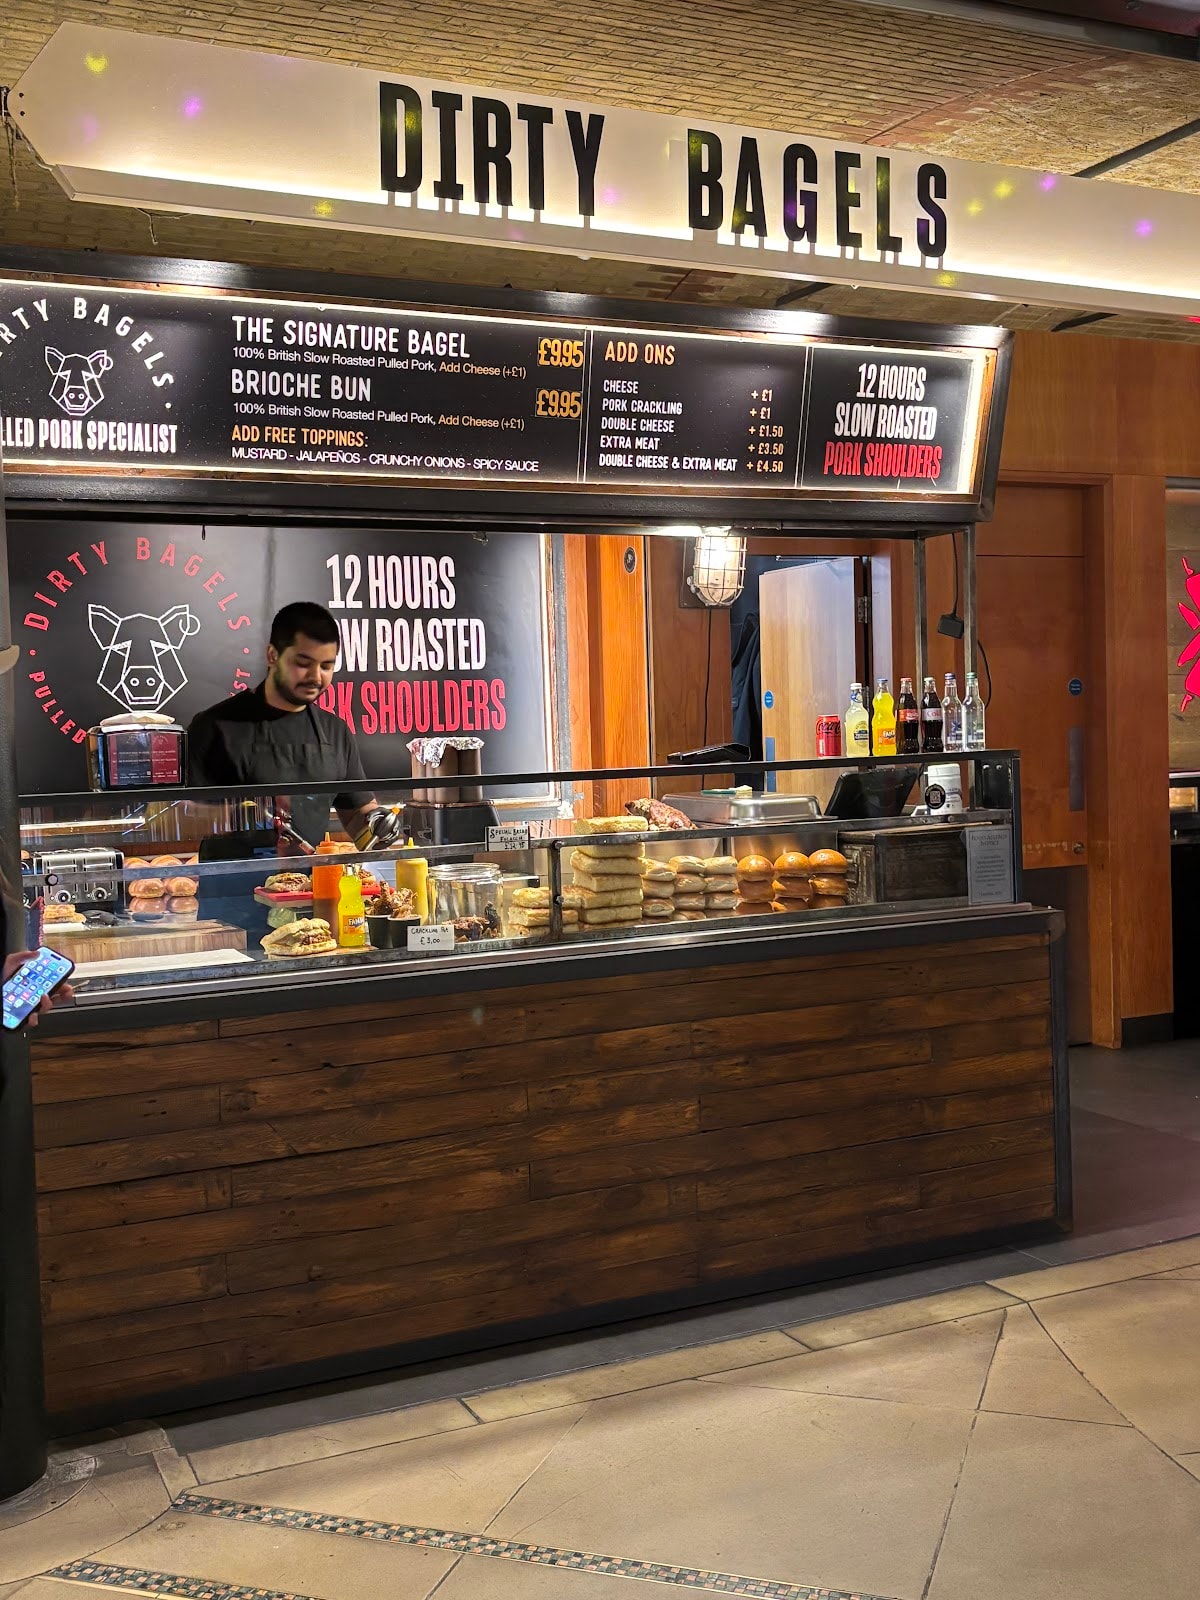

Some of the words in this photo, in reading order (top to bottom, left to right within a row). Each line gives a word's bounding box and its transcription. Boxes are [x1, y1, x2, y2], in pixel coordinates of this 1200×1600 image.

[379, 81, 605, 216] DIRTY
[687, 128, 948, 257] BAGELS
[0, 299, 49, 345] RTY
[73, 297, 175, 388] BAGELS
[232, 315, 274, 343] THE
[283, 320, 399, 353] SIGNATURE
[408, 329, 470, 358] BAGEL
[233, 347, 265, 359] 100%
[268, 349, 301, 362] British
[303, 351, 329, 364] Slow
[332, 353, 375, 367] Roasted
[378, 357, 408, 370] Pulled
[411, 359, 437, 373] Pork,
[439, 361, 460, 373] Add
[462, 363, 500, 376] Cheese
[502, 366, 527, 379] (+£1)
[538, 338, 584, 368] £9.95
[605, 341, 638, 363] ADD
[644, 343, 676, 366] ONS
[231, 368, 322, 398] BRIOCHE
[330, 375, 371, 402] BUN
[603, 379, 639, 394] CHEESE
[751, 390, 759, 399] +
[761, 389, 773, 402] £1
[856, 363, 877, 398] 12
[878, 364, 927, 401] HOURS
[233, 402, 265, 415] 100%
[268, 404, 301, 417] British
[303, 406, 329, 418] Slow
[332, 408, 375, 421] Roasted
[377, 410, 408, 423] Pulled
[410, 413, 436, 426] Pork,
[438, 415, 459, 426] Add
[461, 416, 499, 428] Cheese
[501, 418, 525, 432] (+£1)
[536, 389, 583, 418] £9.95
[602, 398, 627, 412] PORK
[631, 400, 683, 415] CRACKLING
[750, 408, 757, 417] +
[760, 407, 771, 420] £1
[38, 418, 83, 450] PORK
[86, 420, 178, 453] SPECIALIST
[231, 424, 260, 442] ADD
[264, 426, 297, 444] FREE
[301, 428, 369, 447] TOPPINGS:
[601, 417, 636, 431] DOUBLE
[640, 418, 675, 433] CHEESE
[749, 426, 756, 435] +
[759, 425, 784, 438] £1.50
[834, 401, 877, 438] SLOW
[876, 403, 938, 441] ROASTED
[600, 435, 632, 449] EXTRA
[635, 437, 660, 450] MEAT
[748, 443, 755, 452] +
[758, 443, 784, 456] £3.50
[231, 447, 287, 460] MUSTARD
[369, 453, 423, 466] CRUNCHY
[424, 456, 465, 468] ONIONS
[473, 458, 504, 470] SPICY
[504, 459, 539, 472] SAUCE
[599, 453, 633, 468] DOUBLE
[636, 455, 669, 469] CHEESE
[672, 457, 680, 469] &
[682, 457, 712, 470] EXTRA
[714, 458, 738, 472] MEAT
[746, 461, 754, 470] +
[756, 461, 784, 473] £4.50
[823, 441, 864, 476] PORK
[864, 442, 943, 479] SHOULDERS
[23, 541, 109, 631] DIRTY
[136, 537, 251, 631] BAGELS
[326, 554, 363, 609] 12
[367, 555, 456, 610] HOURS
[375, 617, 487, 672] ROASTED
[29, 671, 87, 744] PULLED
[361, 679, 507, 735] SHOULDERS
